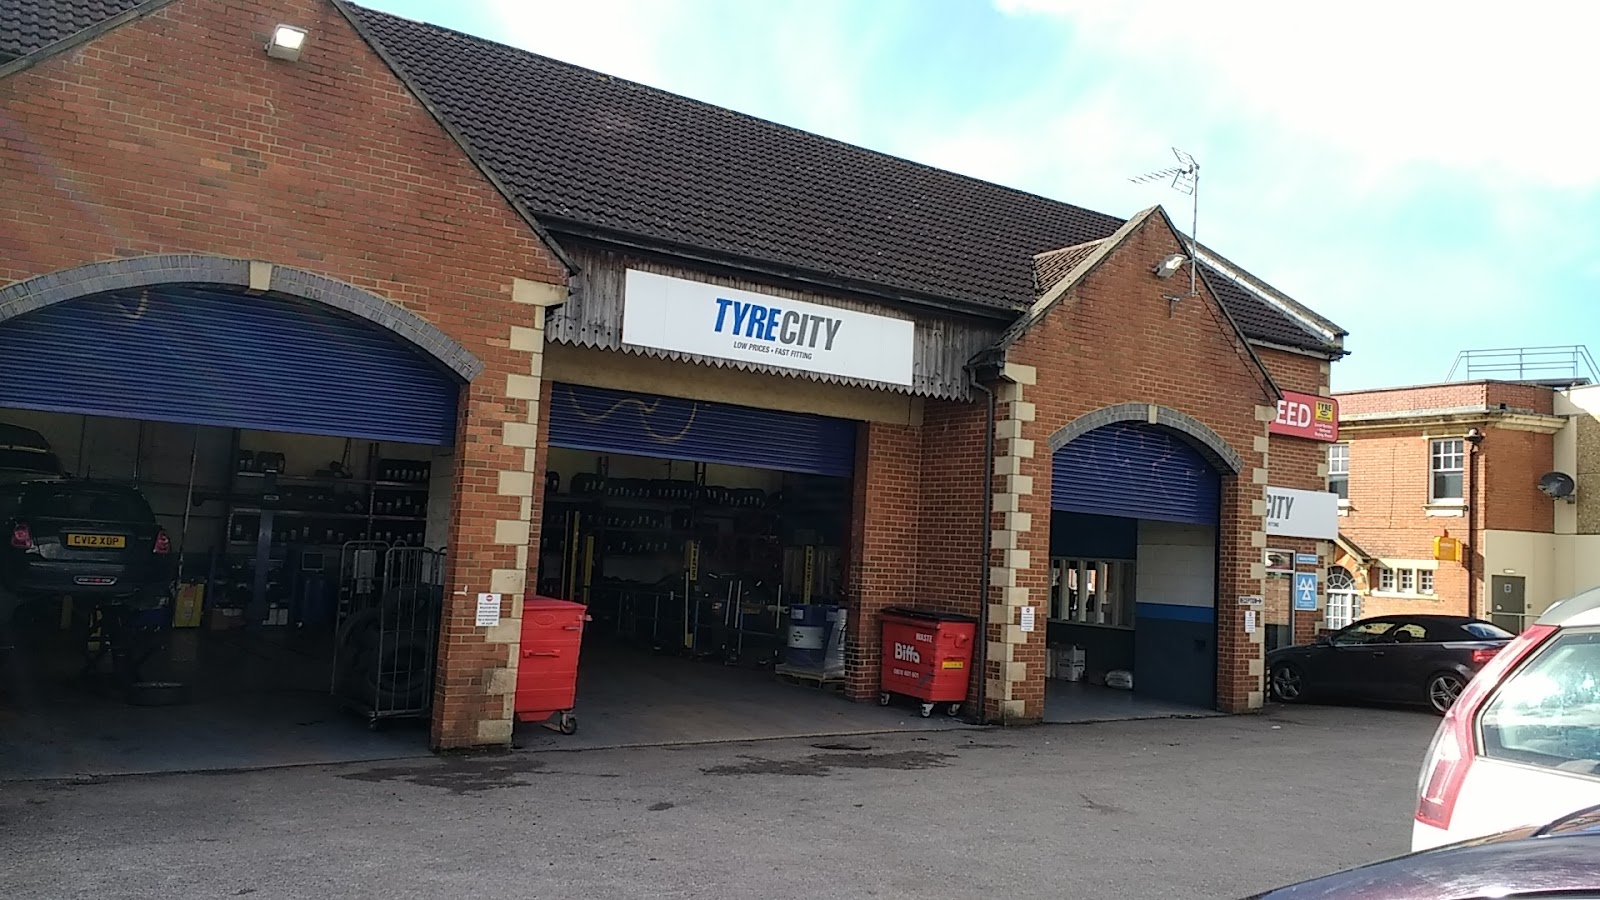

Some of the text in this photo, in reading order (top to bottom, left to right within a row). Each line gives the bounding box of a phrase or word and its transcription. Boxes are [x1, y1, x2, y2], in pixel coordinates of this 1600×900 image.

[714, 298, 842, 351] TYRECITY
[733, 341, 812, 360] LOW PRICES FAST FITTING
[74, 536, 97, 544] CV12
[916, 632, 932, 642] WASTE
[894, 642, 920, 664] Biffa
